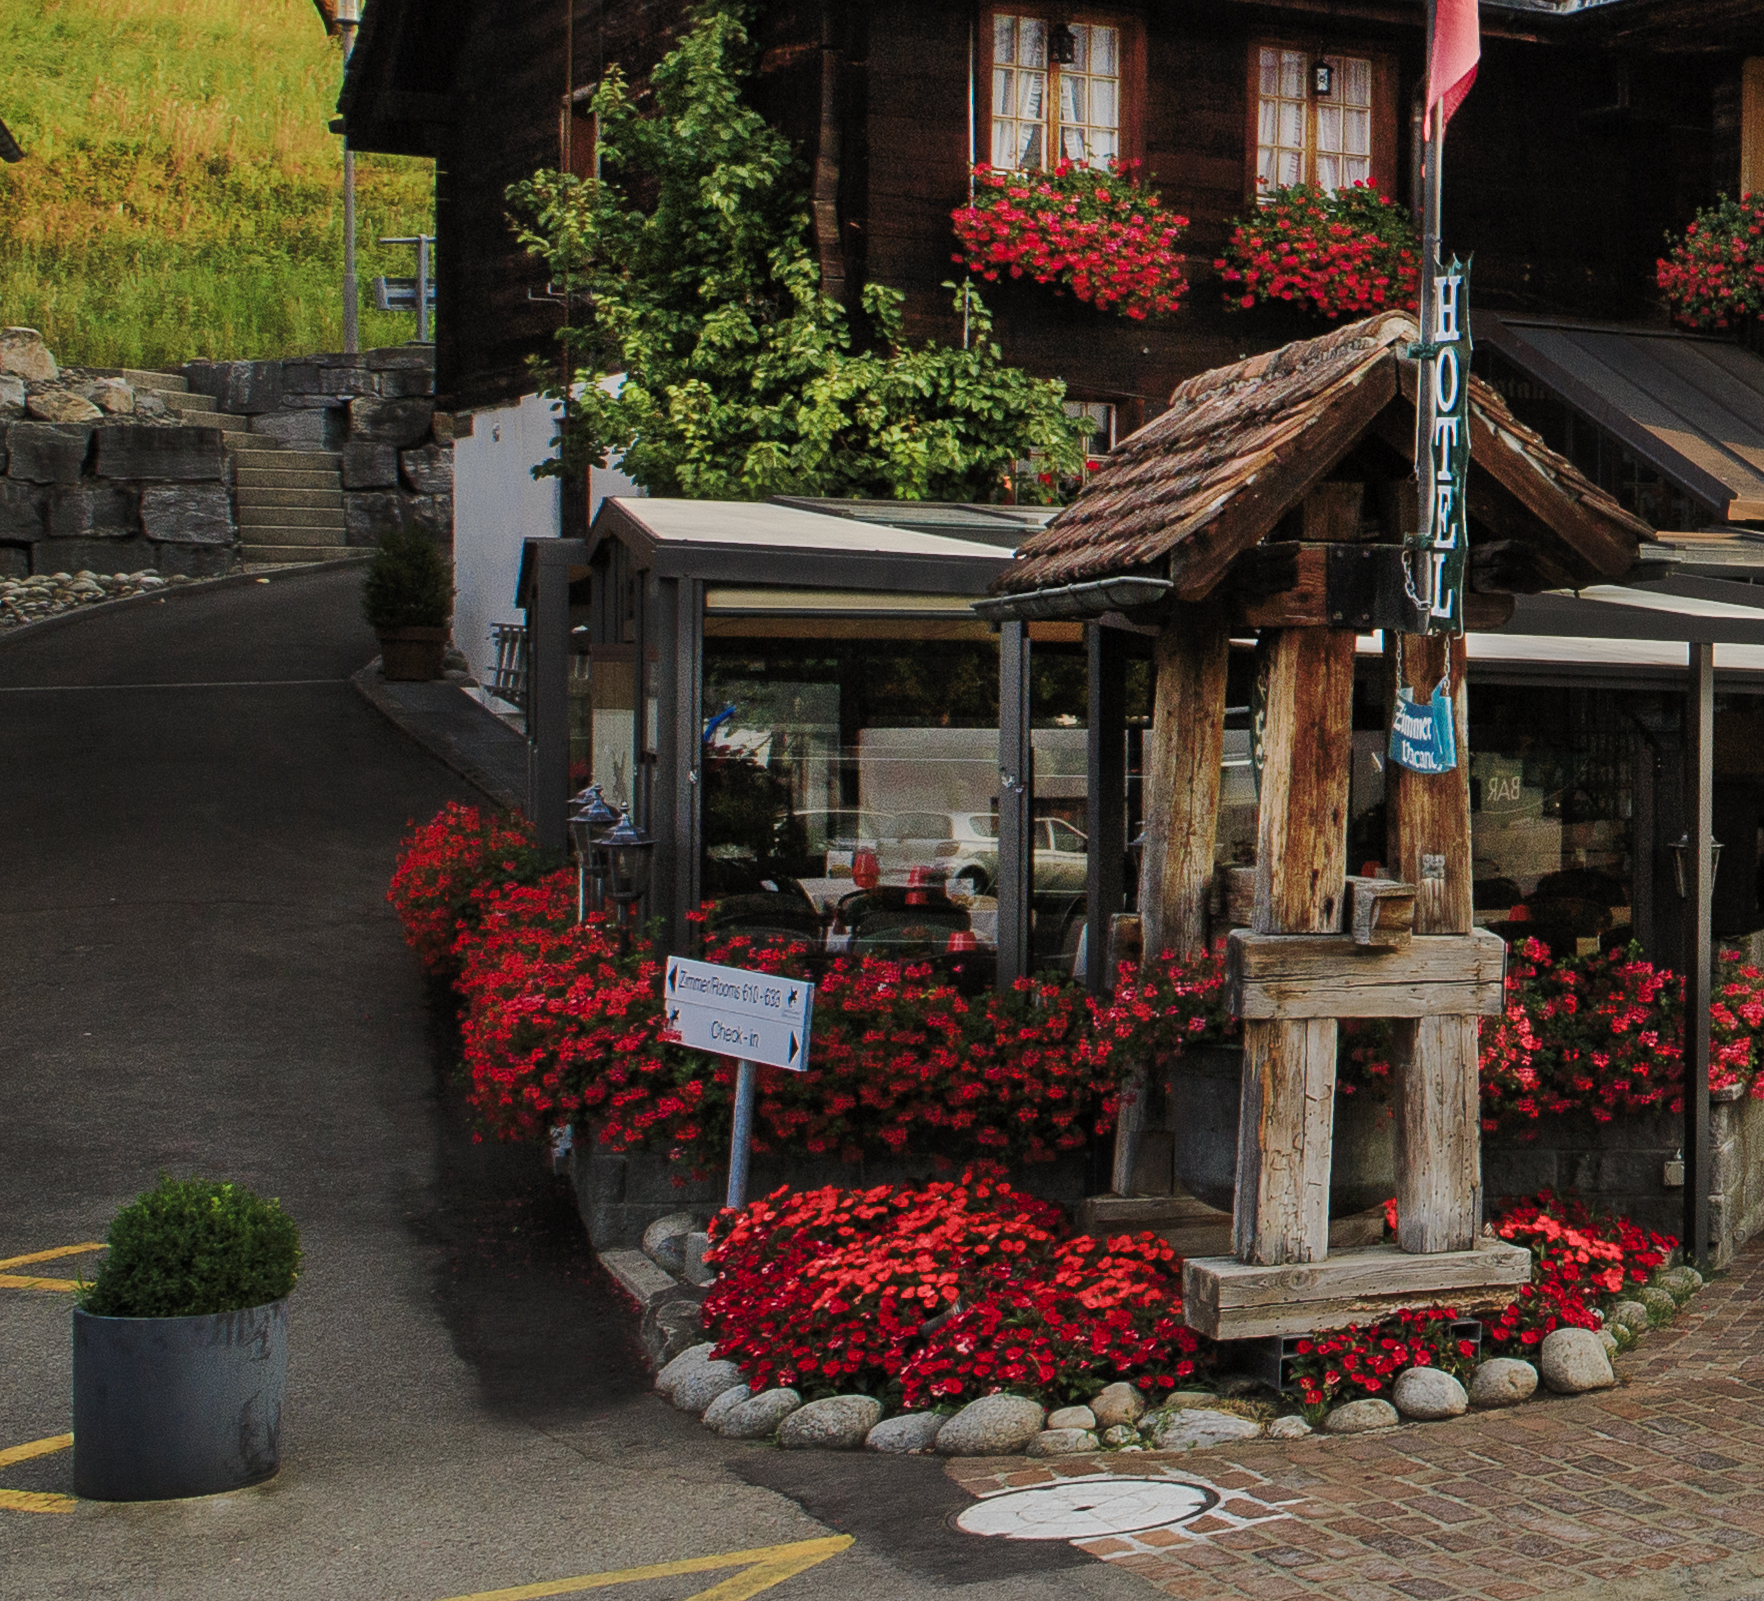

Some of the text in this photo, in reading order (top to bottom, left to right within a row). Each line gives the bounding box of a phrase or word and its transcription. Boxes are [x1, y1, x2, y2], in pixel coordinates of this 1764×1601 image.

[1431, 275, 1461, 619] HOTEL
[1393, 698, 1433, 741] Zimmer
[1401, 739, 1443, 772] Vacanc
